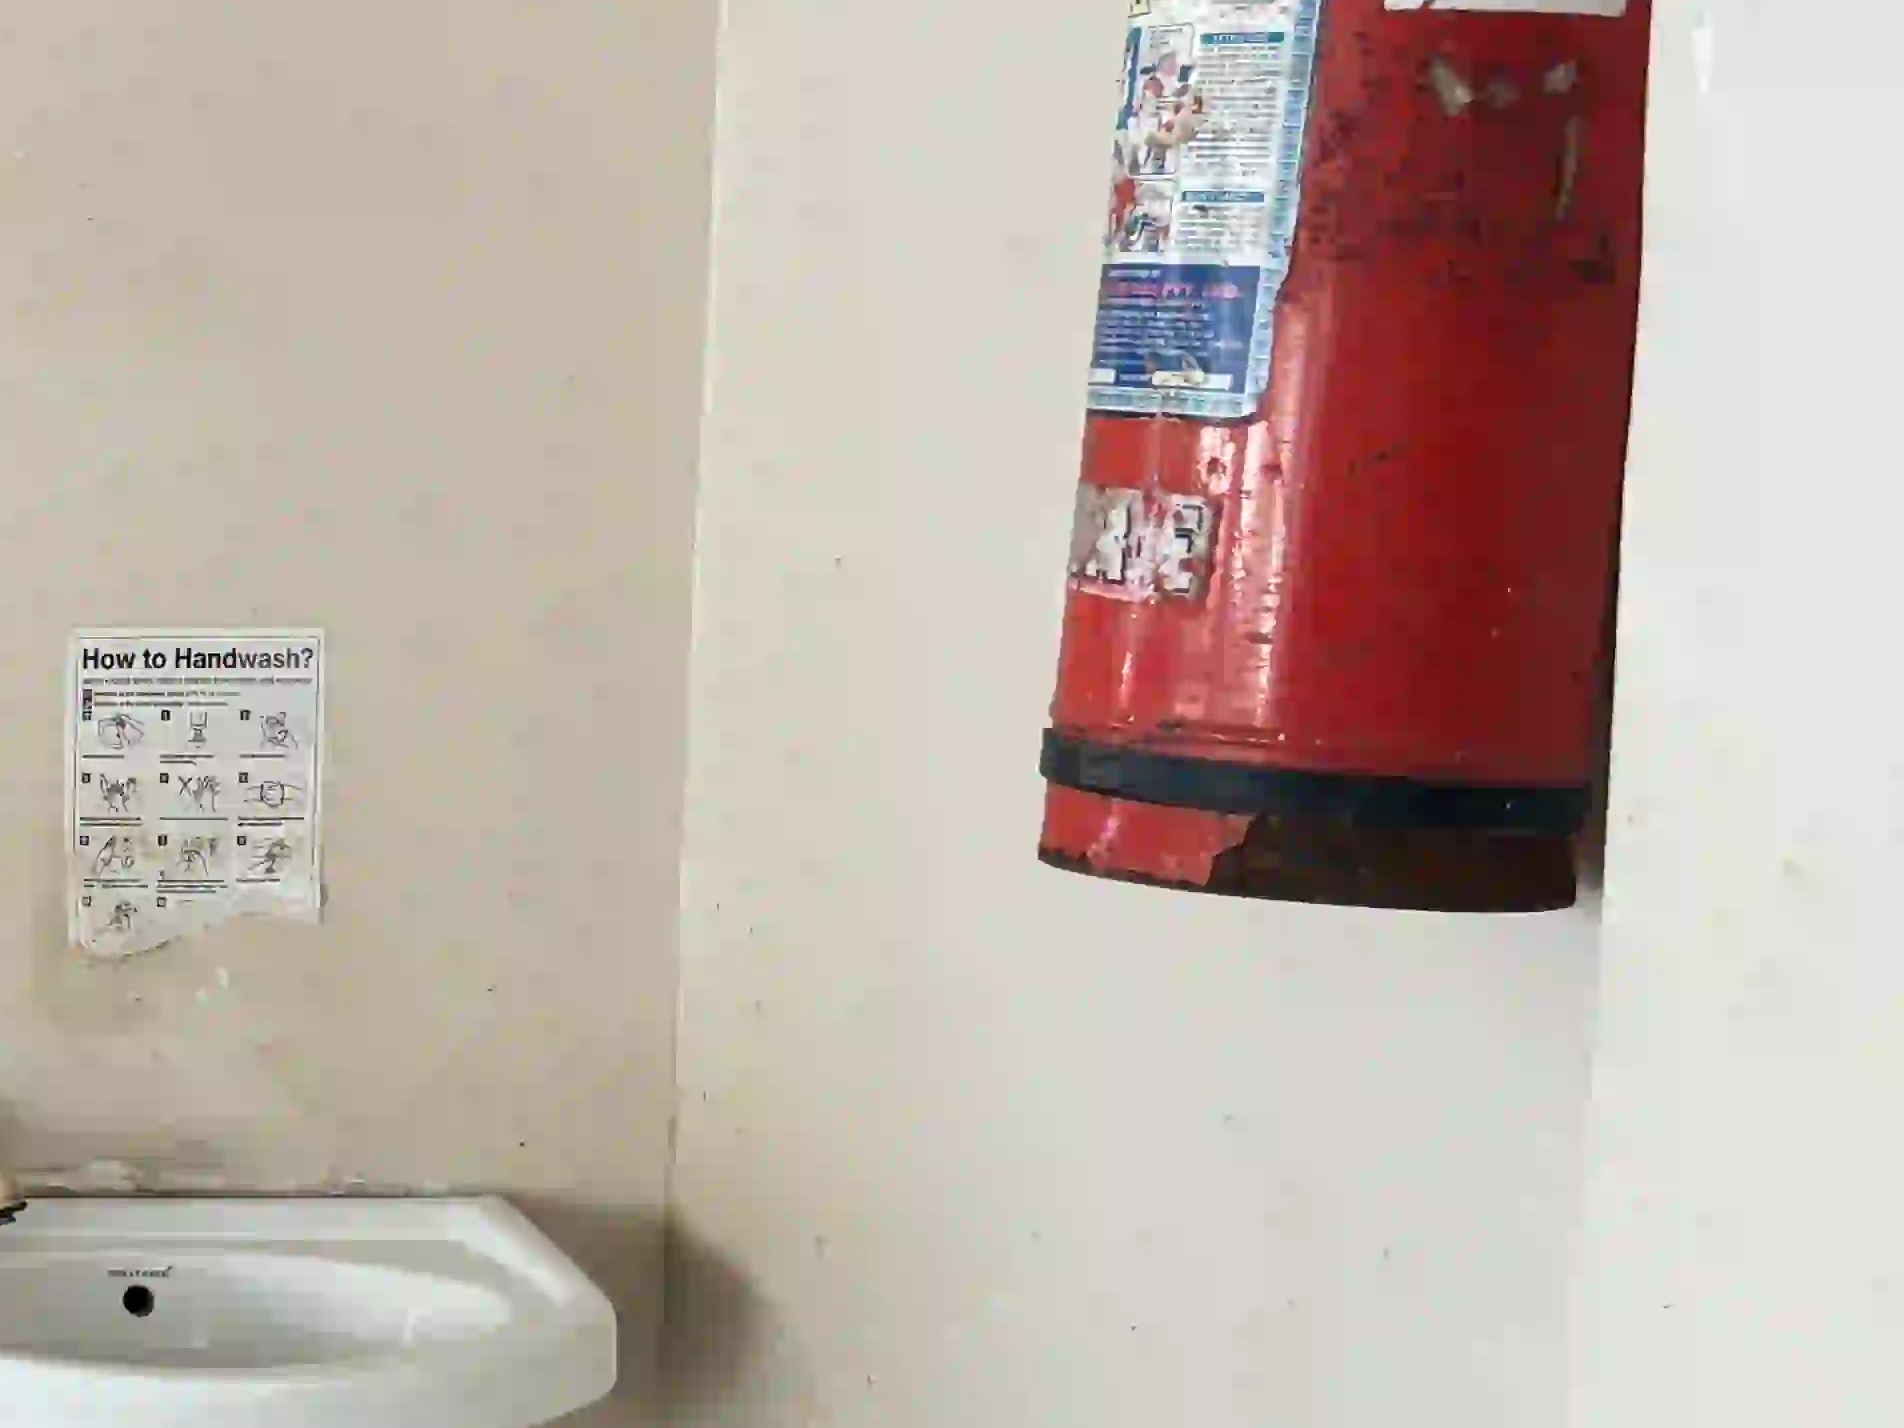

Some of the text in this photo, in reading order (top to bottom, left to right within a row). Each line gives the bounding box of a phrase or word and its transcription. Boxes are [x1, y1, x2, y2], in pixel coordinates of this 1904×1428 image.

[82, 647, 314, 670] How to Handwash?
